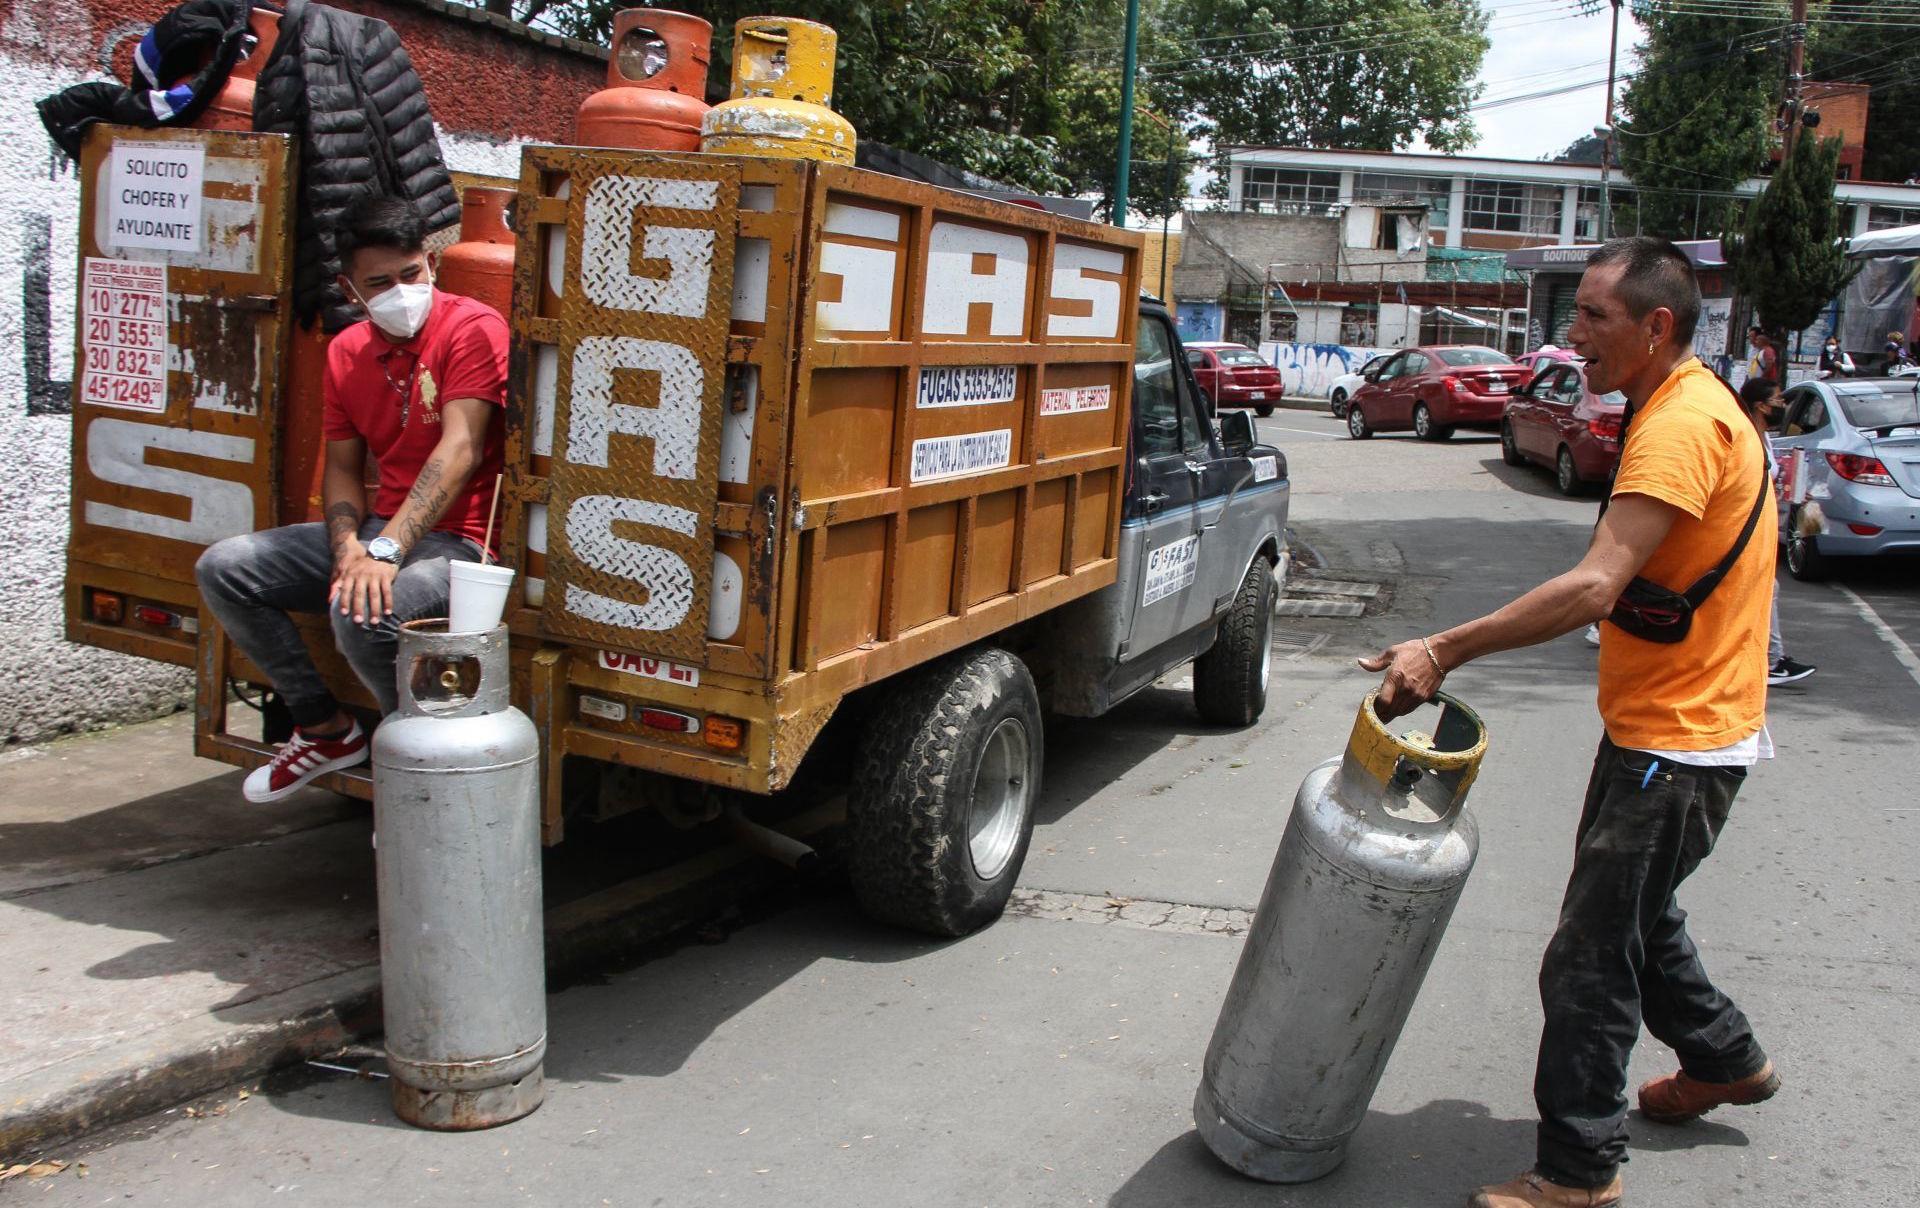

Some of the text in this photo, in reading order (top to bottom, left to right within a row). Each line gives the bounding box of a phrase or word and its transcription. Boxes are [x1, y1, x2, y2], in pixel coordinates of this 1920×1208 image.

[126, 159, 188, 178] SOLICITO
[122, 188, 190, 209] CHOFER Y
[117, 218, 193, 240] AYUDANTE
[1543, 250, 1589, 262] BOUTIQUE
[91, 289, 110, 313] 10
[90, 318, 110, 341] 20
[90, 347, 109, 370] 30
[88, 375, 109, 399] 45
[919, 367, 1015, 404] FUGAS 5353-2515
[565, 174, 719, 632] GAS
[1040, 391, 1071, 412] MATERIAL
